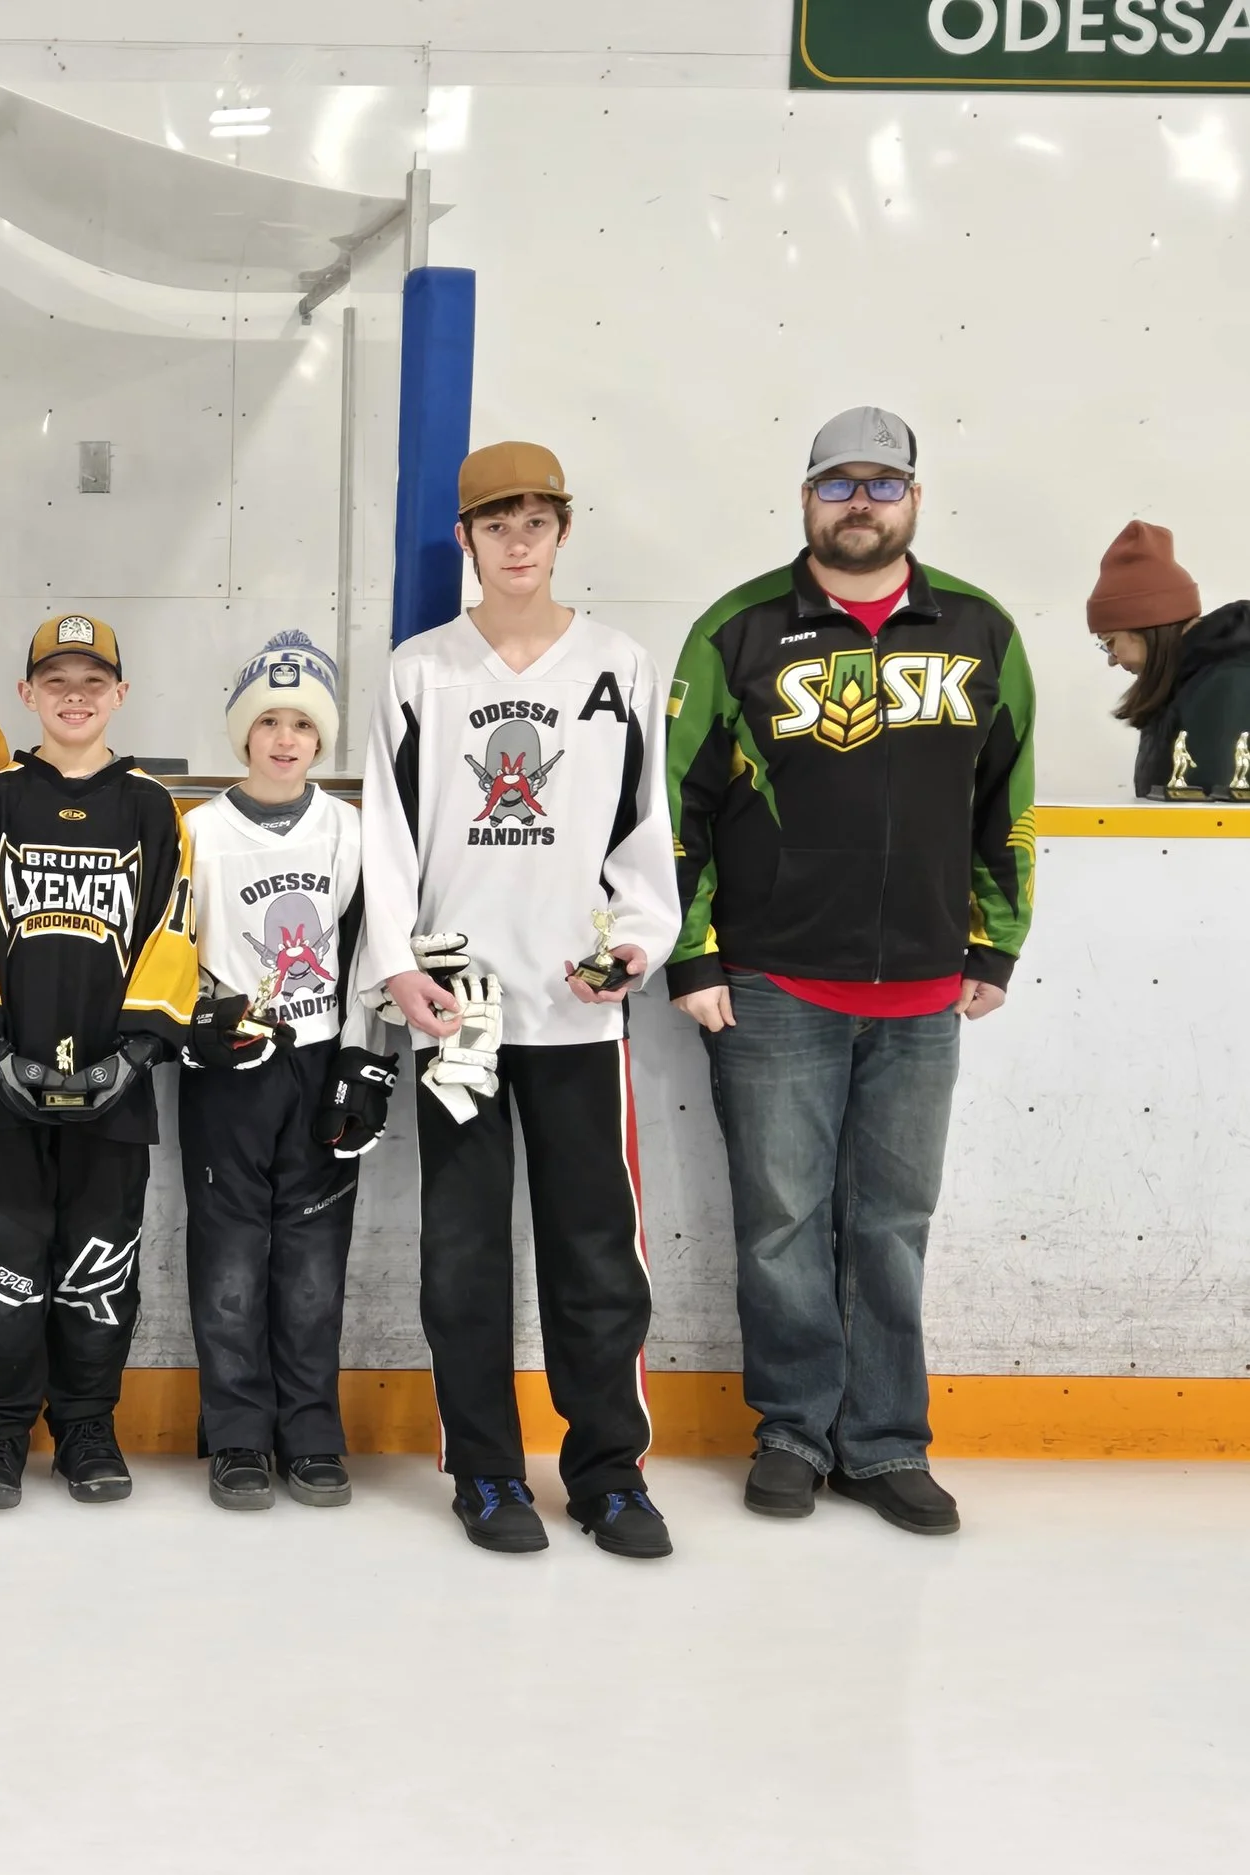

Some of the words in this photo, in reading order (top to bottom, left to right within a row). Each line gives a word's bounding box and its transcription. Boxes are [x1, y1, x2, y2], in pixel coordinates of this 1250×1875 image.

[928, 0, 1250, 54] ODESSA
[578, 671, 628, 723] A
[469, 700, 559, 729] ODESSA
[467, 827, 555, 846] BANDITS
[25, 851, 113, 870] BRUNO
[4, 852, 139, 950] AXEMEN
[239, 872, 331, 906] ODESSA
[26, 914, 102, 936] BROOMBALL
